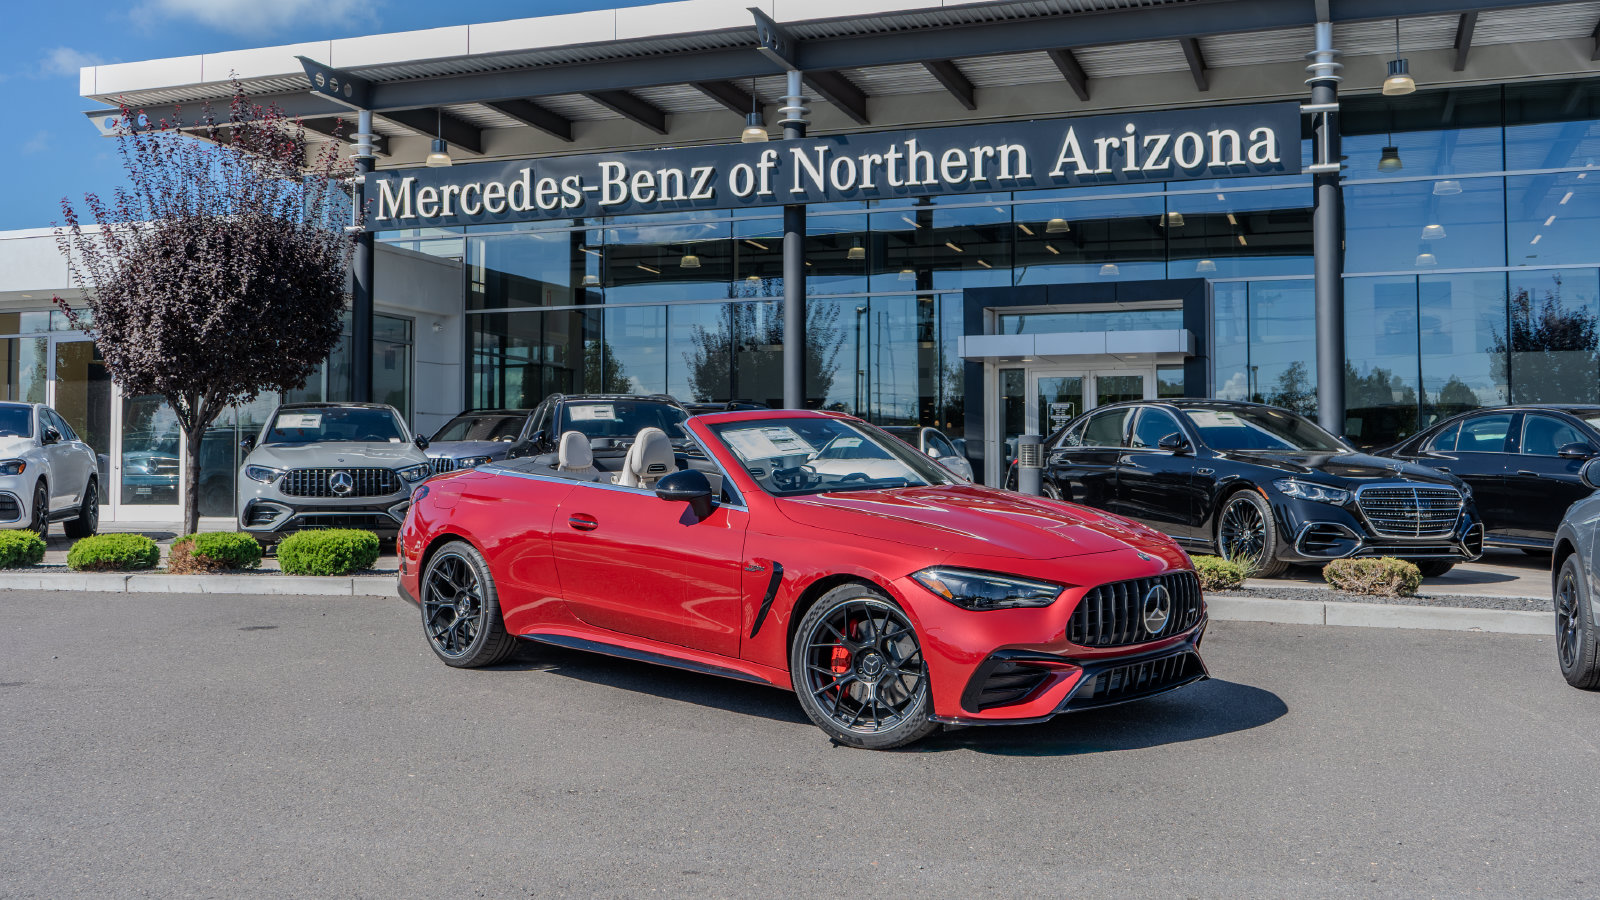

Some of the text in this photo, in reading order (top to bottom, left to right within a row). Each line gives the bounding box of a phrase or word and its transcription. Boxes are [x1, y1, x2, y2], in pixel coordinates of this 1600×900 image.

[375, 123, 1281, 221] Mercedes-Benz of Northern Arizona
